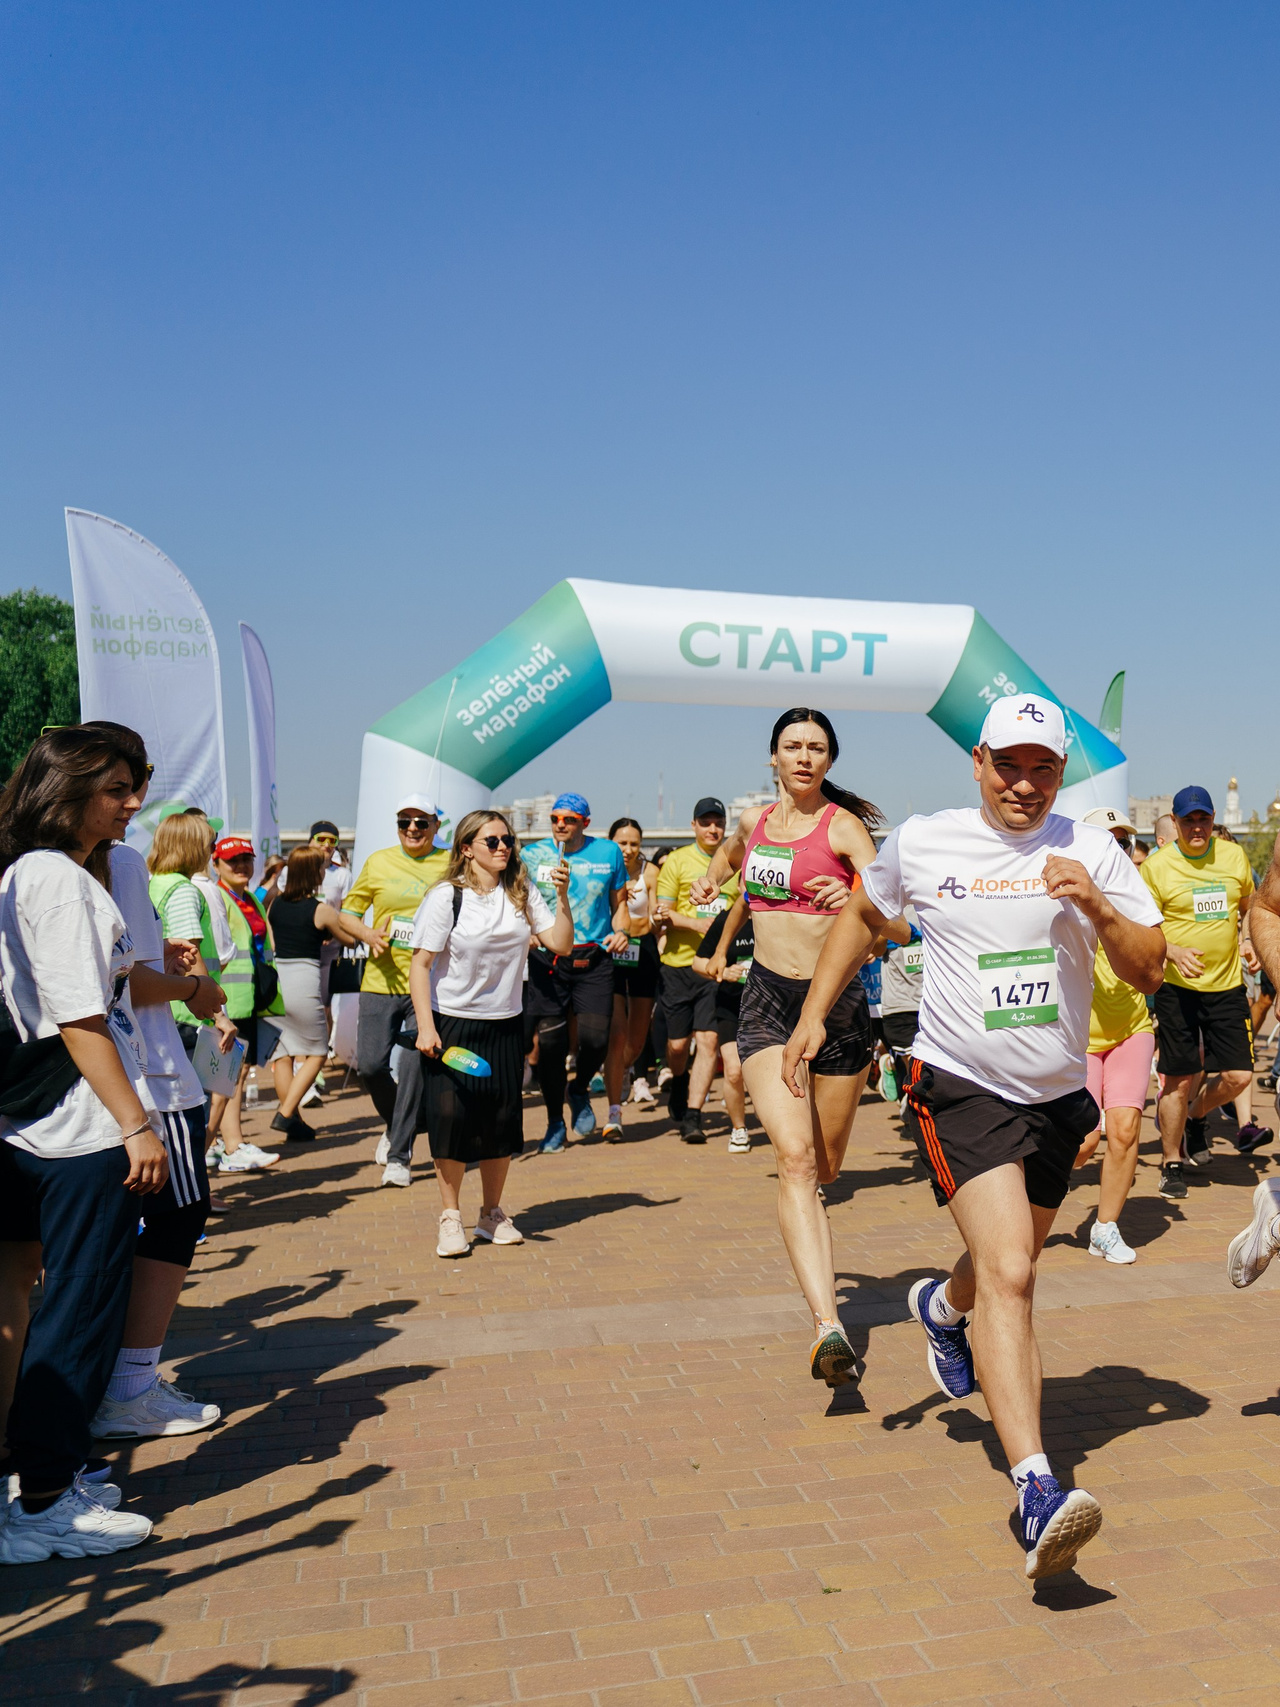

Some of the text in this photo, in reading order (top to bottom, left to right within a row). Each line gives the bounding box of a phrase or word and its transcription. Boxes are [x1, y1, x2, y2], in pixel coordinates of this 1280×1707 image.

[679, 621, 888, 676] СТАРТ
[456, 642, 556, 726] зелёный
[472, 663, 572, 744] марафон
[751, 865, 785, 887] 1490
[1197, 900, 1223, 912] 0007
[393, 929, 414, 941] 000
[991, 981, 1050, 1008] 1477
[1011, 1012, 1036, 1023] 4,2км
